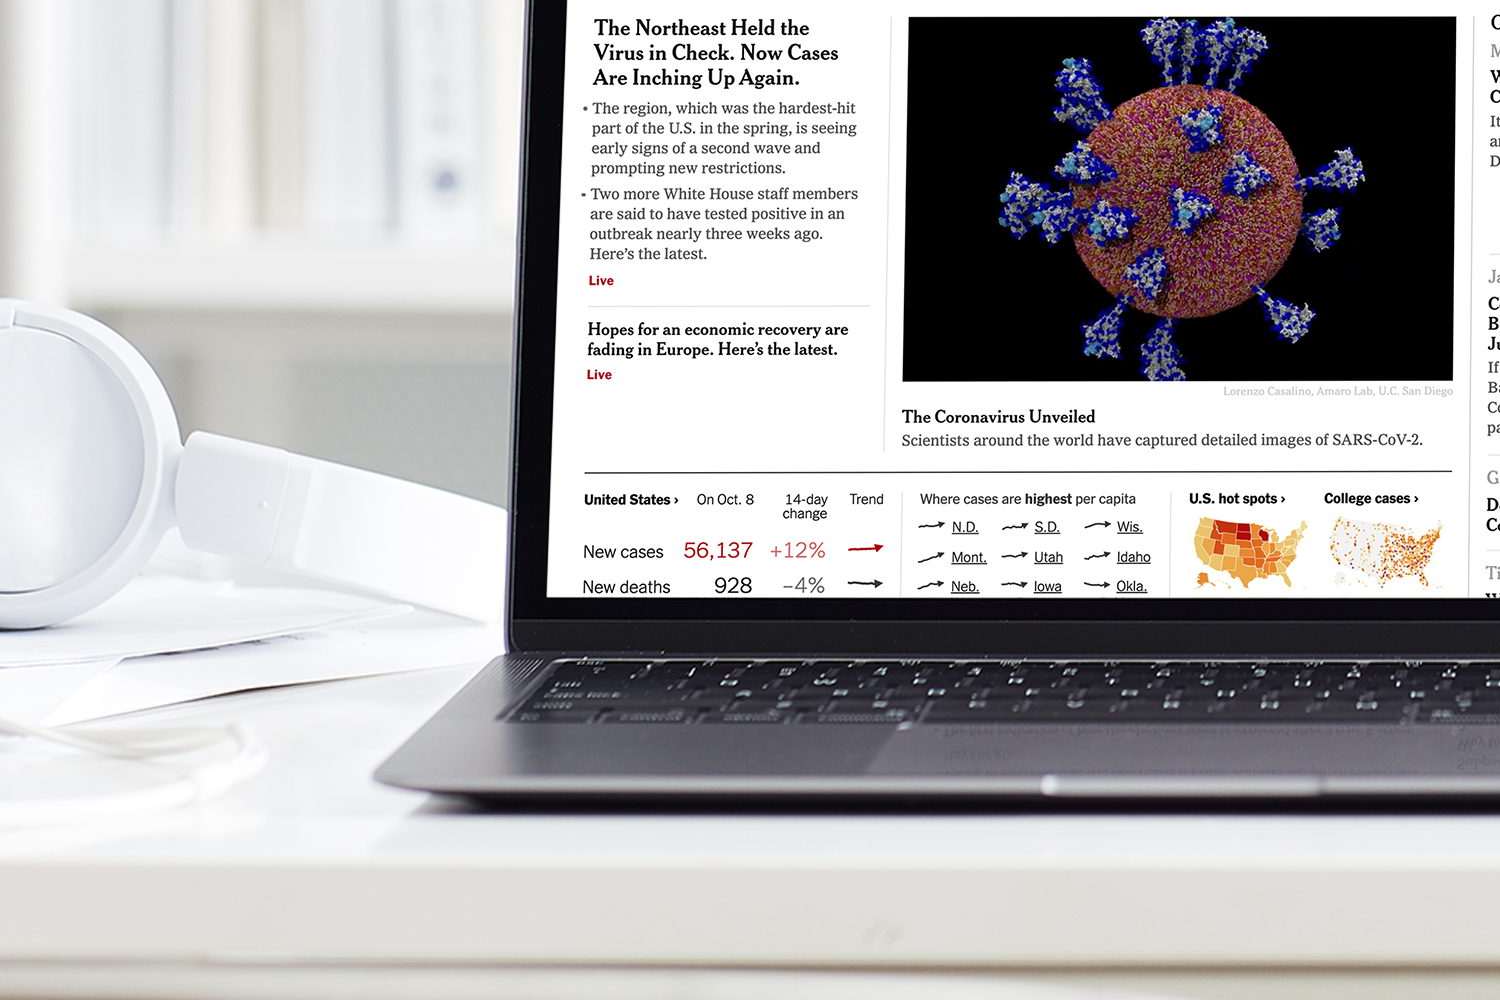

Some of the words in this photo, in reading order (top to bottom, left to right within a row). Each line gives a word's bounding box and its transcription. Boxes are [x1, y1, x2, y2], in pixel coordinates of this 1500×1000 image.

[594, 19, 630, 36] The
[635, 19, 726, 36] Northeast
[731, 19, 775, 36] Held
[780, 19, 809, 36] the
[593, 43, 644, 61] Virus
[649, 44, 667, 60] in
[672, 43, 734, 61] Check.
[740, 43, 783, 60] Now
[787, 43, 839, 60] Cases
[592, 68, 627, 85] Are
[633, 68, 703, 90] Inching
[708, 68, 735, 89] Up
[738, 68, 799, 90] Again.
[591, 162, 665, 177] prompting
[669, 165, 698, 174] new
[702, 161, 785, 174] restrictions.
[589, 275, 614, 286] Live
[588, 322, 634, 339] Hopes
[638, 322, 659, 336] for
[663, 327, 681, 336] an
[685, 322, 754, 336] economic
[758, 326, 821, 339] recovery
[825, 326, 849, 335] are
[1488, 361, 1500, 373] If
[587, 369, 612, 380] Live
[1224, 386, 1265, 396] Lorenzo
[1267, 386, 1314, 396] Casalino,
[1316, 386, 1351, 395] Amaro
[1354, 386, 1376, 396] Lab,
[1379, 386, 1399, 395] U.C.
[1402, 386, 1421, 395] San
[1424, 386, 1453, 397] Diego
[902, 409, 931, 423] The
[935, 409, 1025, 423] Coronavirus
[1029, 409, 1095, 423] Unveiled
[584, 494, 626, 505] United
[629, 494, 671, 505] States
[697, 493, 714, 505] On
[717, 493, 742, 505] Oct.
[746, 494, 754, 505] 8
[786, 494, 828, 507] 14-day
[850, 493, 884, 505] Trend
[1189, 493, 1215, 504] U.S.
[1219, 493, 1240, 504] hot
[1243, 493, 1278, 506] spots
[1324, 492, 1372, 506] College
[1375, 495, 1411, 504] cases
[783, 508, 827, 521] change
[1117, 521, 1143, 533] Wis.
[584, 545, 617, 559] New
[621, 548, 664, 559] cases
[684, 542, 753, 561] 56,137
[770, 542, 825, 558] +12%
[1035, 551, 1063, 563] Utah
[1117, 551, 1151, 563] Idaho
[583, 580, 616, 594] New
[620, 580, 671, 594] deaths
[715, 577, 752, 594] 928
[1033, 581, 1062, 593] Iowa
